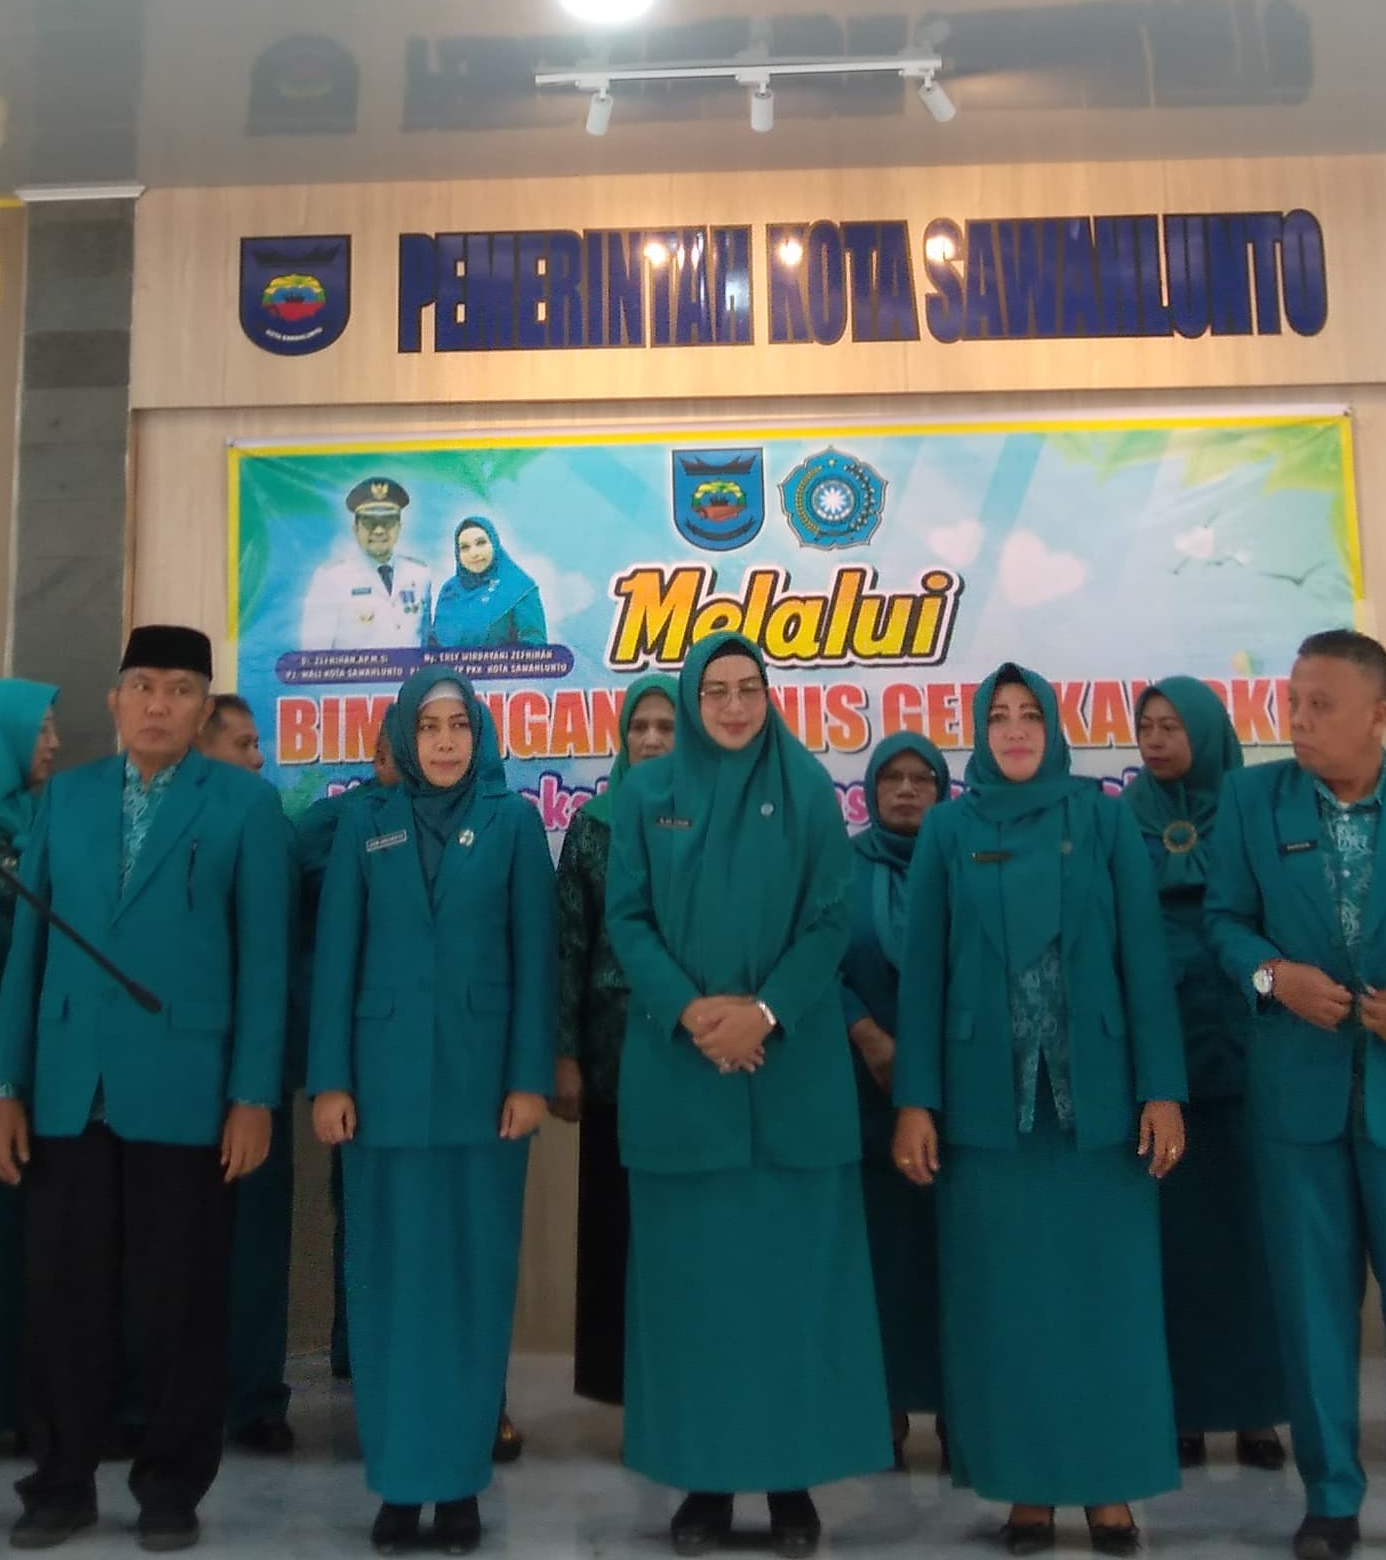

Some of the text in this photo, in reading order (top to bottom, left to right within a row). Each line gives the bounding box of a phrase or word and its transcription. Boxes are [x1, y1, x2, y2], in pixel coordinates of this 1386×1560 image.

[398, 208, 1328, 353] PEMERINTAH KOTA SAWAHLUNTO
[608, 564, 960, 669] Melalui
